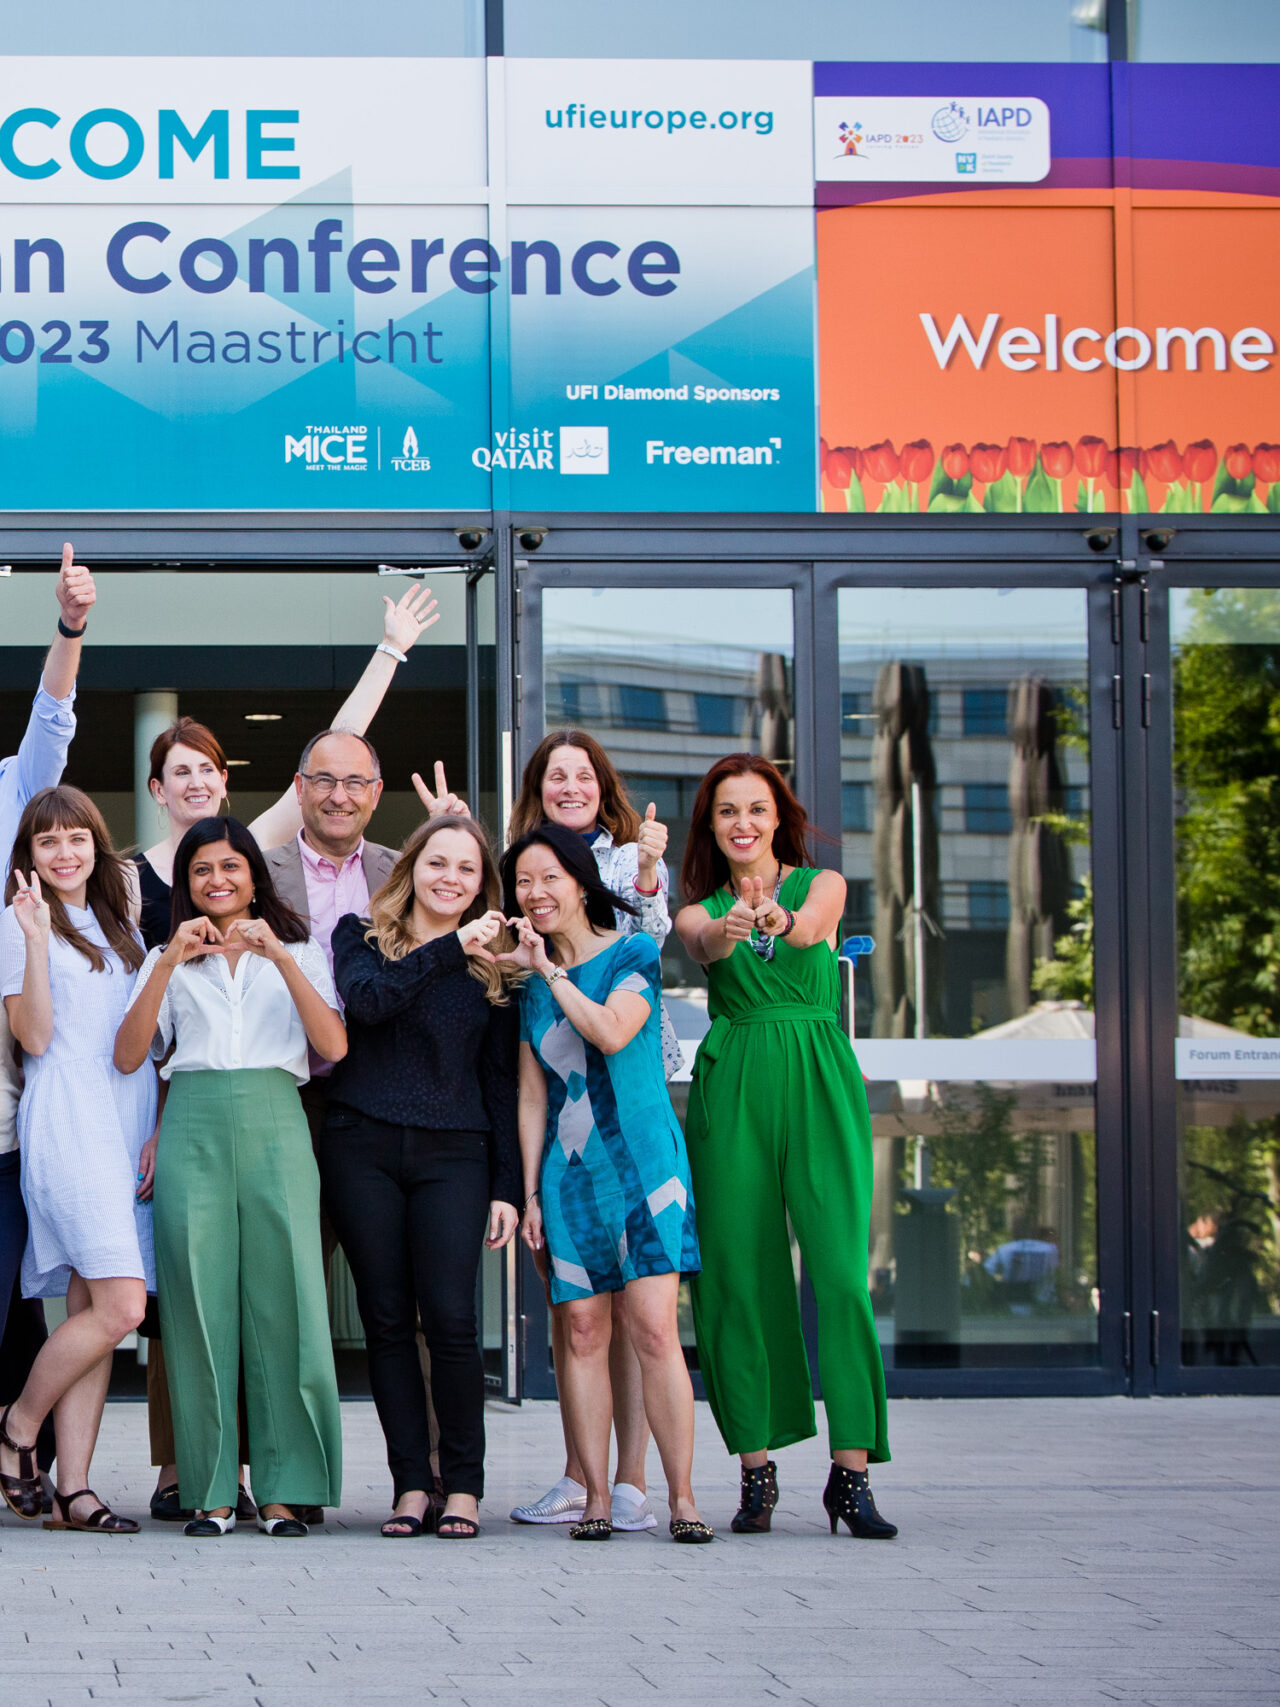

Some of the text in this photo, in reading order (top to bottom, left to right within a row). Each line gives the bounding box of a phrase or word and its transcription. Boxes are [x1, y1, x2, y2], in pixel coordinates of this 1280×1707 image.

[545, 103, 775, 135] ufieurope.org
[977, 107, 1033, 128] IAPD
[865, 134, 893, 143] IAPD
[107, 218, 680, 297] Conference
[137, 318, 444, 364] Maastricht
[920, 312, 1274, 373] Welcome
[566, 385, 780, 403] UFI Diamond Sponsors
[305, 425, 368, 434] THAILAND
[495, 427, 554, 449] visit
[285, 434, 368, 464] MICE
[471, 447, 554, 472] QATAR
[646, 440, 773, 464] Freeman
[391, 459, 431, 471] TCEB
[1189, 1050, 1280, 1060] Forum Entran
